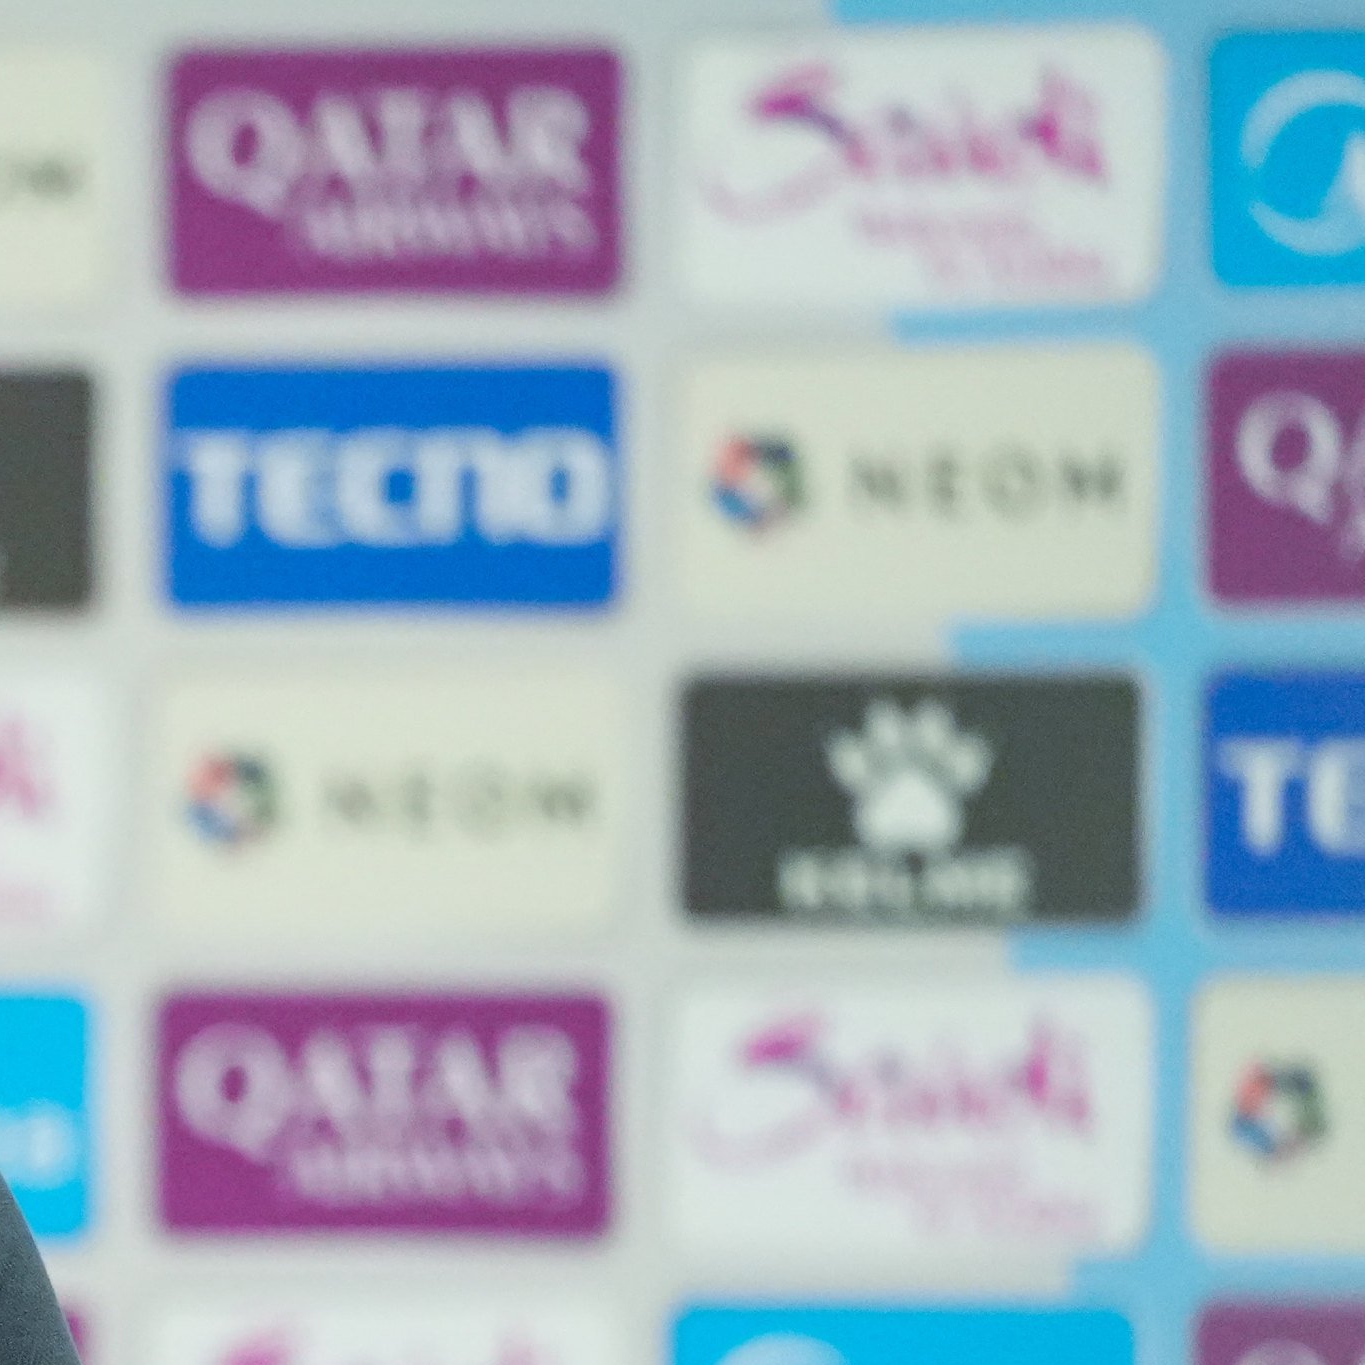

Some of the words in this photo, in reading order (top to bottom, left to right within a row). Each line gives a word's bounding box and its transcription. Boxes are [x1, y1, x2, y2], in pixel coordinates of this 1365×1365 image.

[186, 88, 590, 218] QATAR
[172, 428, 610, 548] TECNO
[174, 1020, 580, 1162] QATAR
